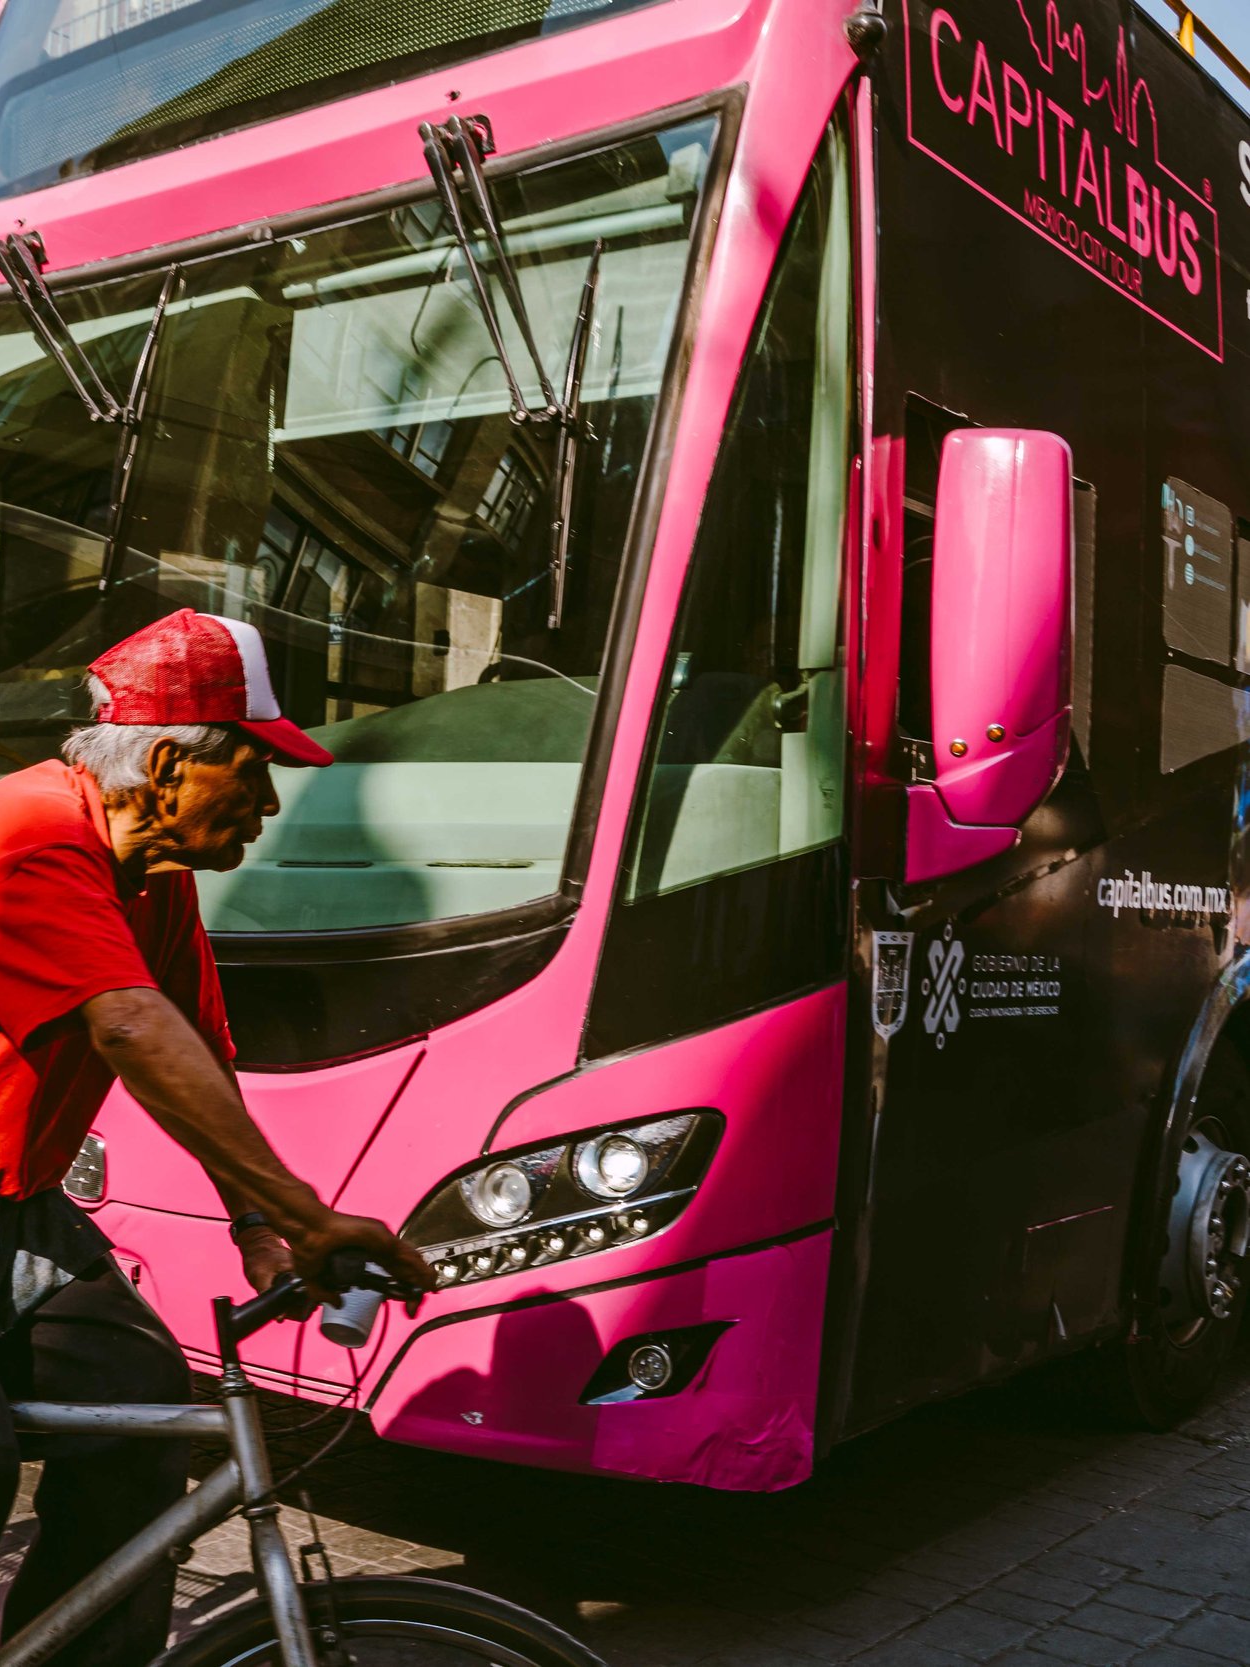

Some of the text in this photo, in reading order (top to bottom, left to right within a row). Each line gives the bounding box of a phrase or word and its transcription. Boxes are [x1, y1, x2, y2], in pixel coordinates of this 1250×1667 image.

[930, 8, 1202, 296] CAPITALBUS
[1024, 188, 1143, 297] MEXICO CITY TOUR
[1097, 868, 1227, 918] capitalbus.com.mx
[972, 954, 1061, 972] GOBIERNO DE LA
[970, 981, 1009, 998] CIUDAD
[1011, 981, 1024, 998] DE
